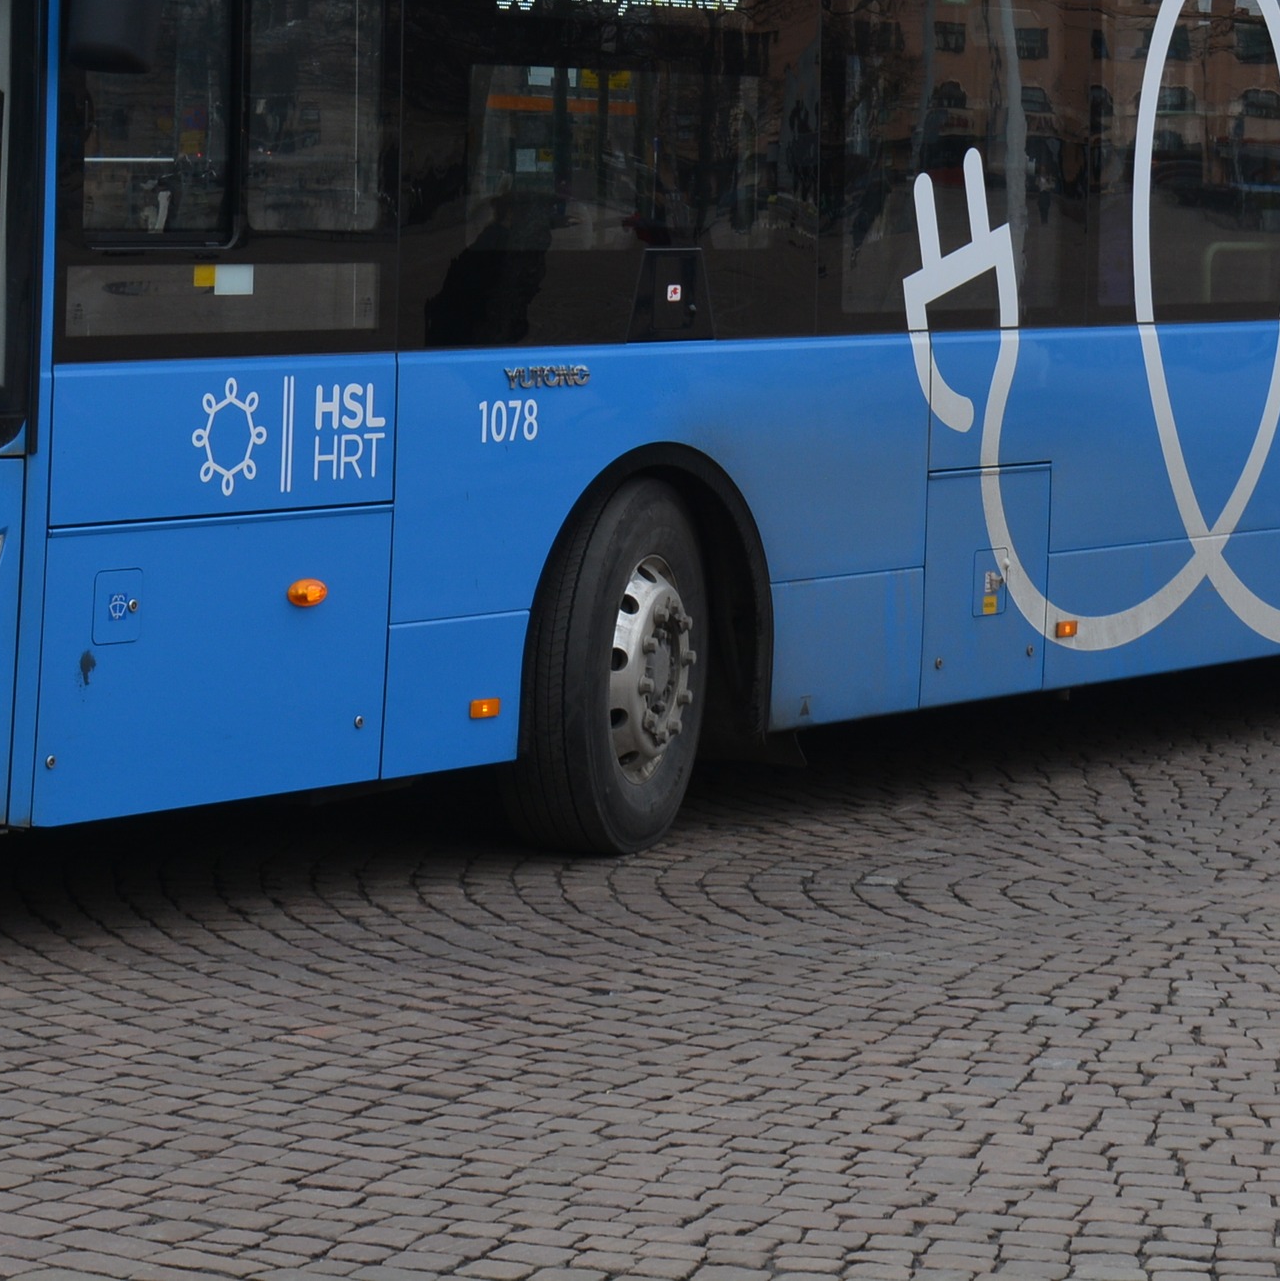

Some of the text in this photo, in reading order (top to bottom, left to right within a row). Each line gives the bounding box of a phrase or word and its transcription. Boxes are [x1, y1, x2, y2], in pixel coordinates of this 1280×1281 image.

[504, 364, 591, 391] YUTONG
[314, 383, 386, 431] HSL
[479, 399, 538, 443] 1078
[313, 433, 386, 481] HRT
